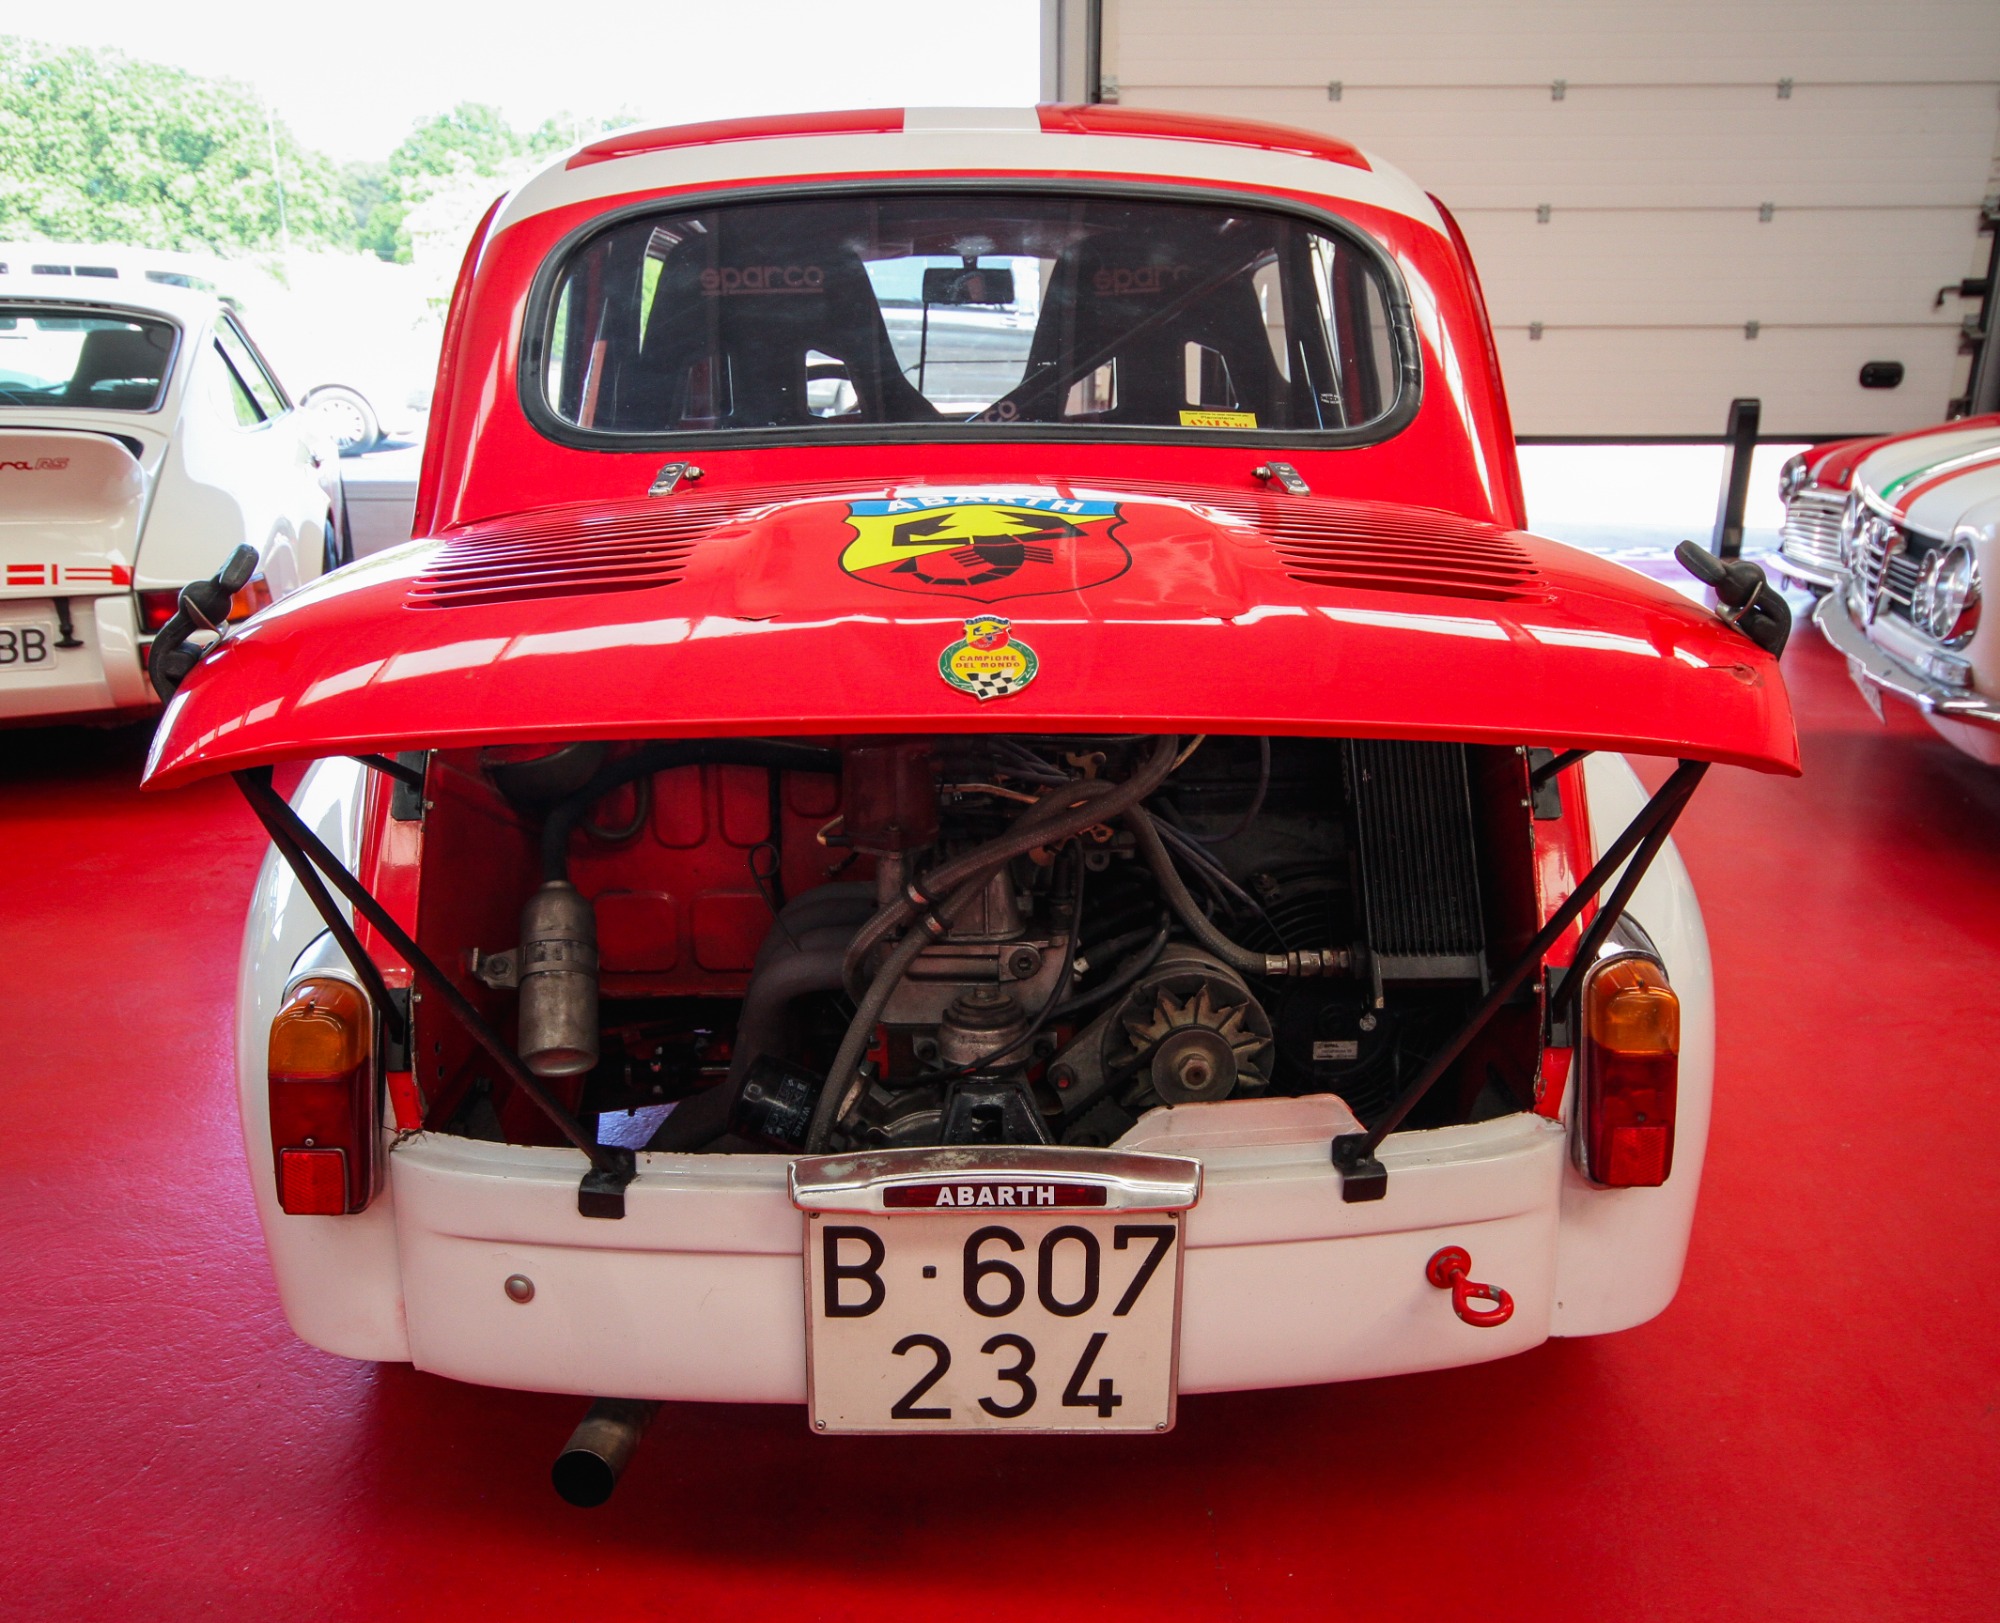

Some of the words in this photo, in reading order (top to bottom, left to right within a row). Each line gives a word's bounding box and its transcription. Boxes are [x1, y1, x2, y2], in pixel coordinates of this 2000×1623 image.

[701, 265, 824, 296] sparco
[35, 458, 69, 470] RS
[887, 495, 1084, 512] ABARTH
[936, 1186, 1055, 1205] ABARTH
[891, 1333, 1123, 1419] 234
